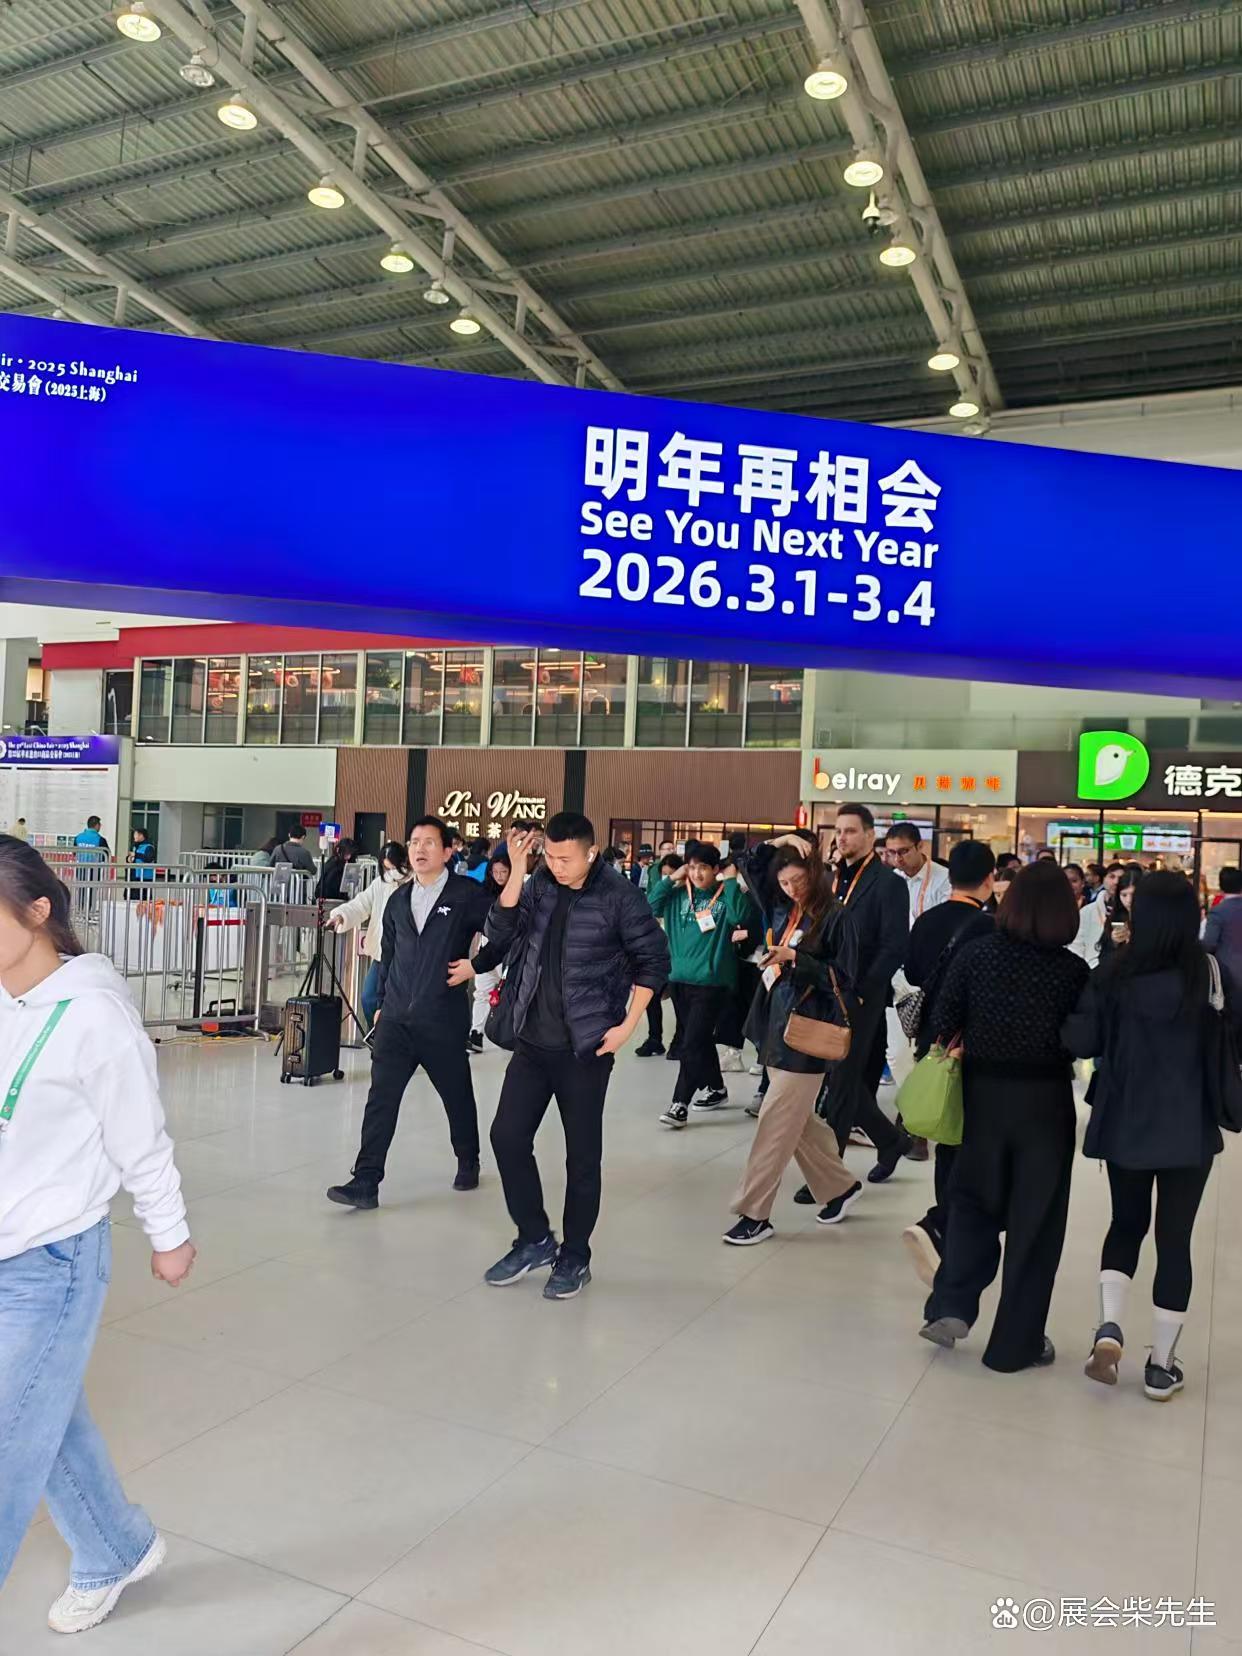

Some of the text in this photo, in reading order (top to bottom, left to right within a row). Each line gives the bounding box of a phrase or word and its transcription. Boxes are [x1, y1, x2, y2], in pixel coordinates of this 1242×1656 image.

[28, 359, 66, 377] 2025
[69, 361, 138, 385] Shanghai
[584, 426, 942, 534] 明年再相会
[580, 501, 939, 568] See You Next Year
[579, 548, 936, 626] 2026.3.1-3.4
[813, 757, 901, 796] belray
[1164, 765, 1242, 797] 德克
[487, 790, 546, 819] WANG
